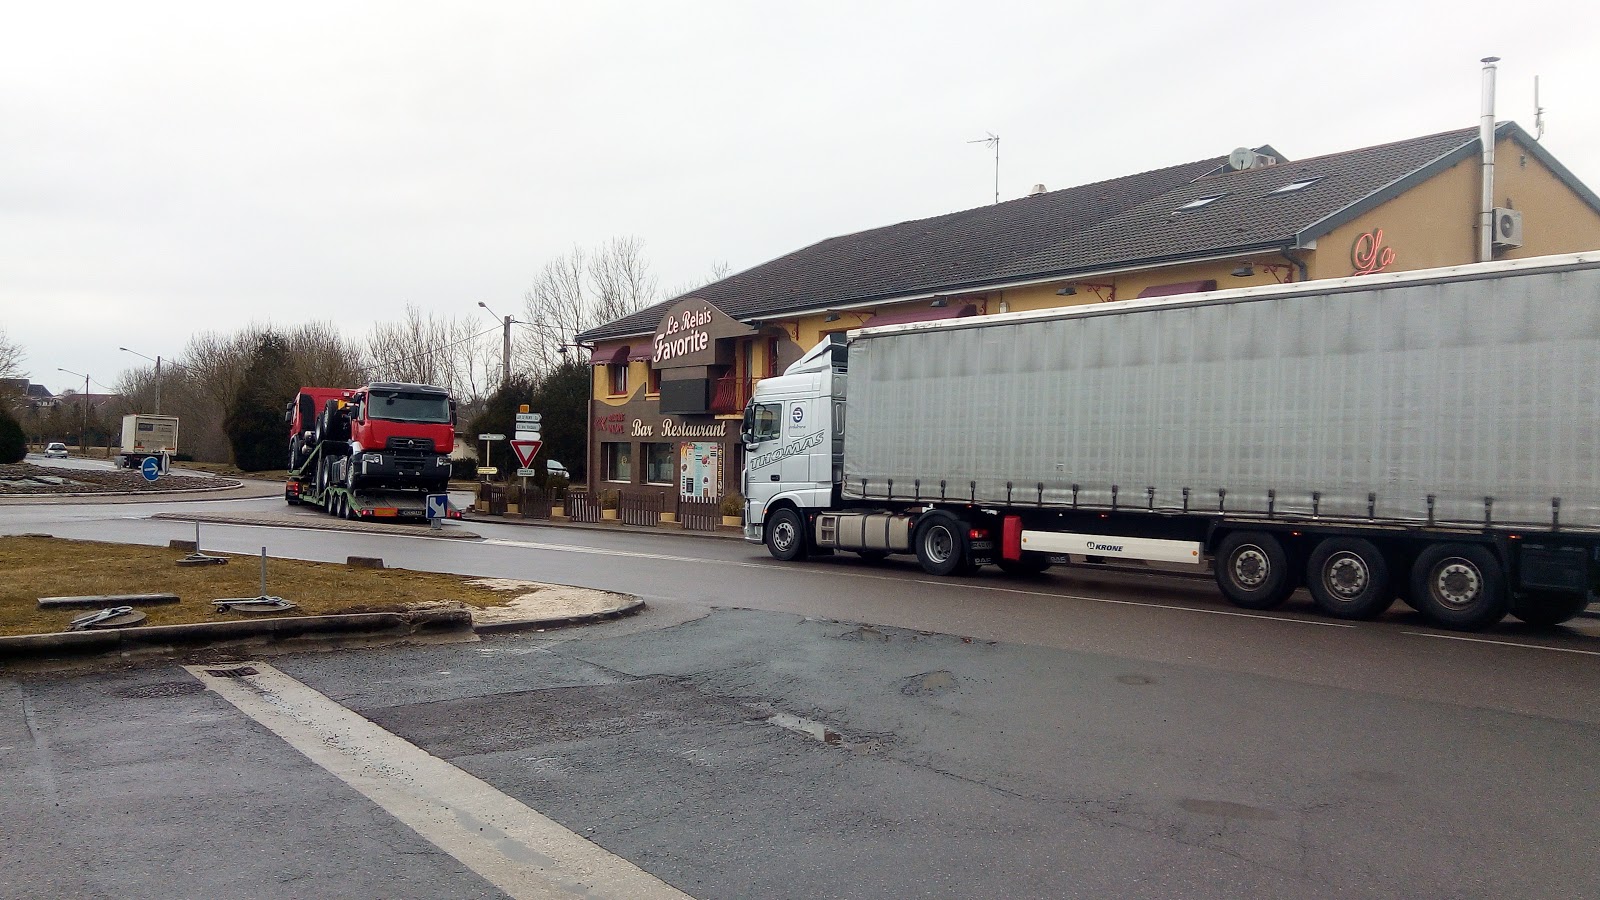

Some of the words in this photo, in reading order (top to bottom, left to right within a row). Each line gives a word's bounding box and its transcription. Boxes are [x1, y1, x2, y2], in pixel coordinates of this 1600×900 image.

[665, 314, 680, 336] Le
[681, 307, 712, 331] Relais
[652, 328, 709, 363] Favorite
[631, 418, 654, 437] Bar
[661, 417, 727, 438] Restaurant
[750, 431, 825, 470] THOMAS
[1095, 543, 1124, 552] KRONE
